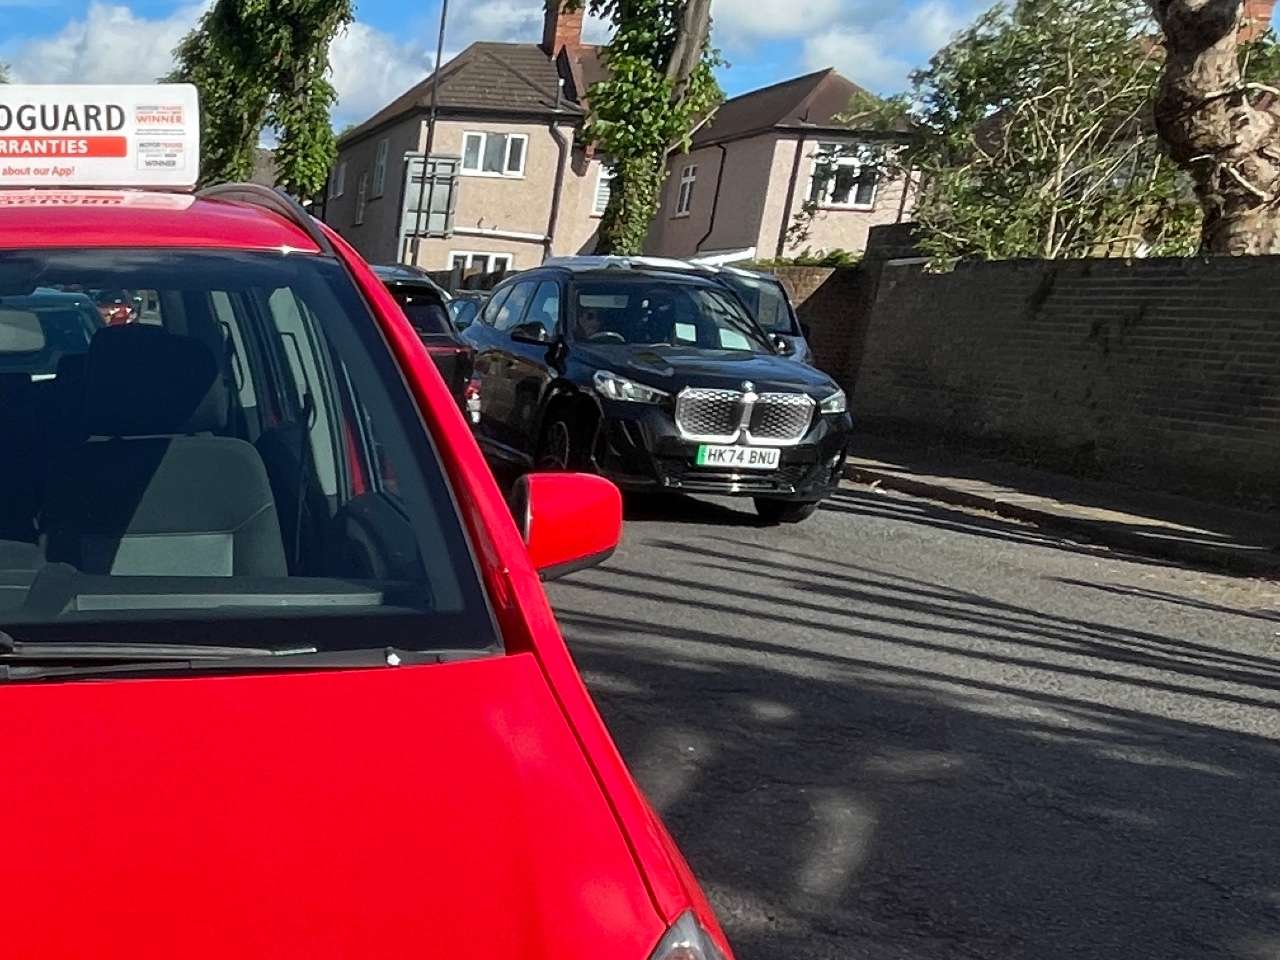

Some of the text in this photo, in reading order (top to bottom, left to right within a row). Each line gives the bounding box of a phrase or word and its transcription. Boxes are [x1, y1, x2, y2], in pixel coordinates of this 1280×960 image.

[3, 166, 30, 176] about
[33, 168, 49, 176] our
[51, 166, 75, 177] App!
[707, 448, 777, 465] HK74 BNU
